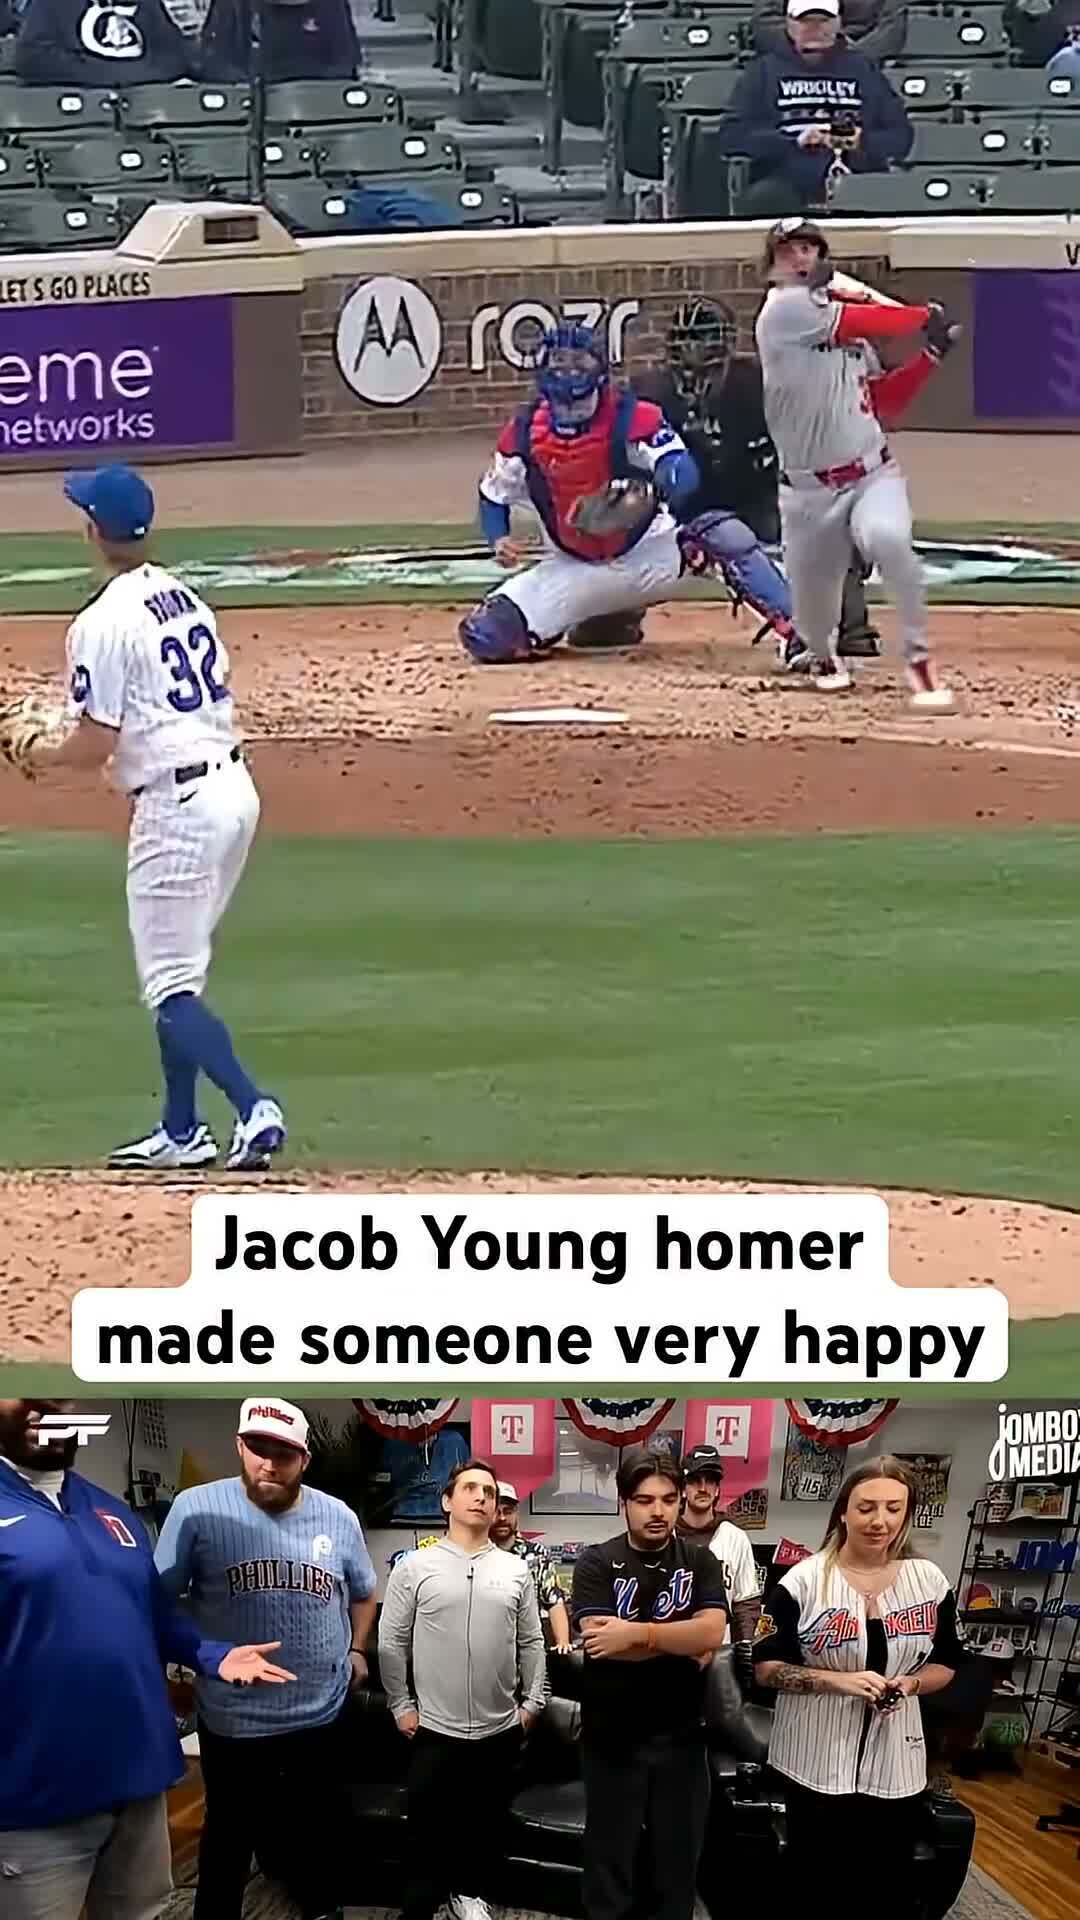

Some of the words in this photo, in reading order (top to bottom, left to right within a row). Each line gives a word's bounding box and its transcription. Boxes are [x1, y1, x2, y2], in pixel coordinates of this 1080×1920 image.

[50, 276, 77, 300] GO
[83, 271, 151, 299] PLACES
[160, 623, 230, 713] 32
[988, 1403, 1080, 1482] jOMBO
[225, 1558, 334, 1602] PHILLIES
